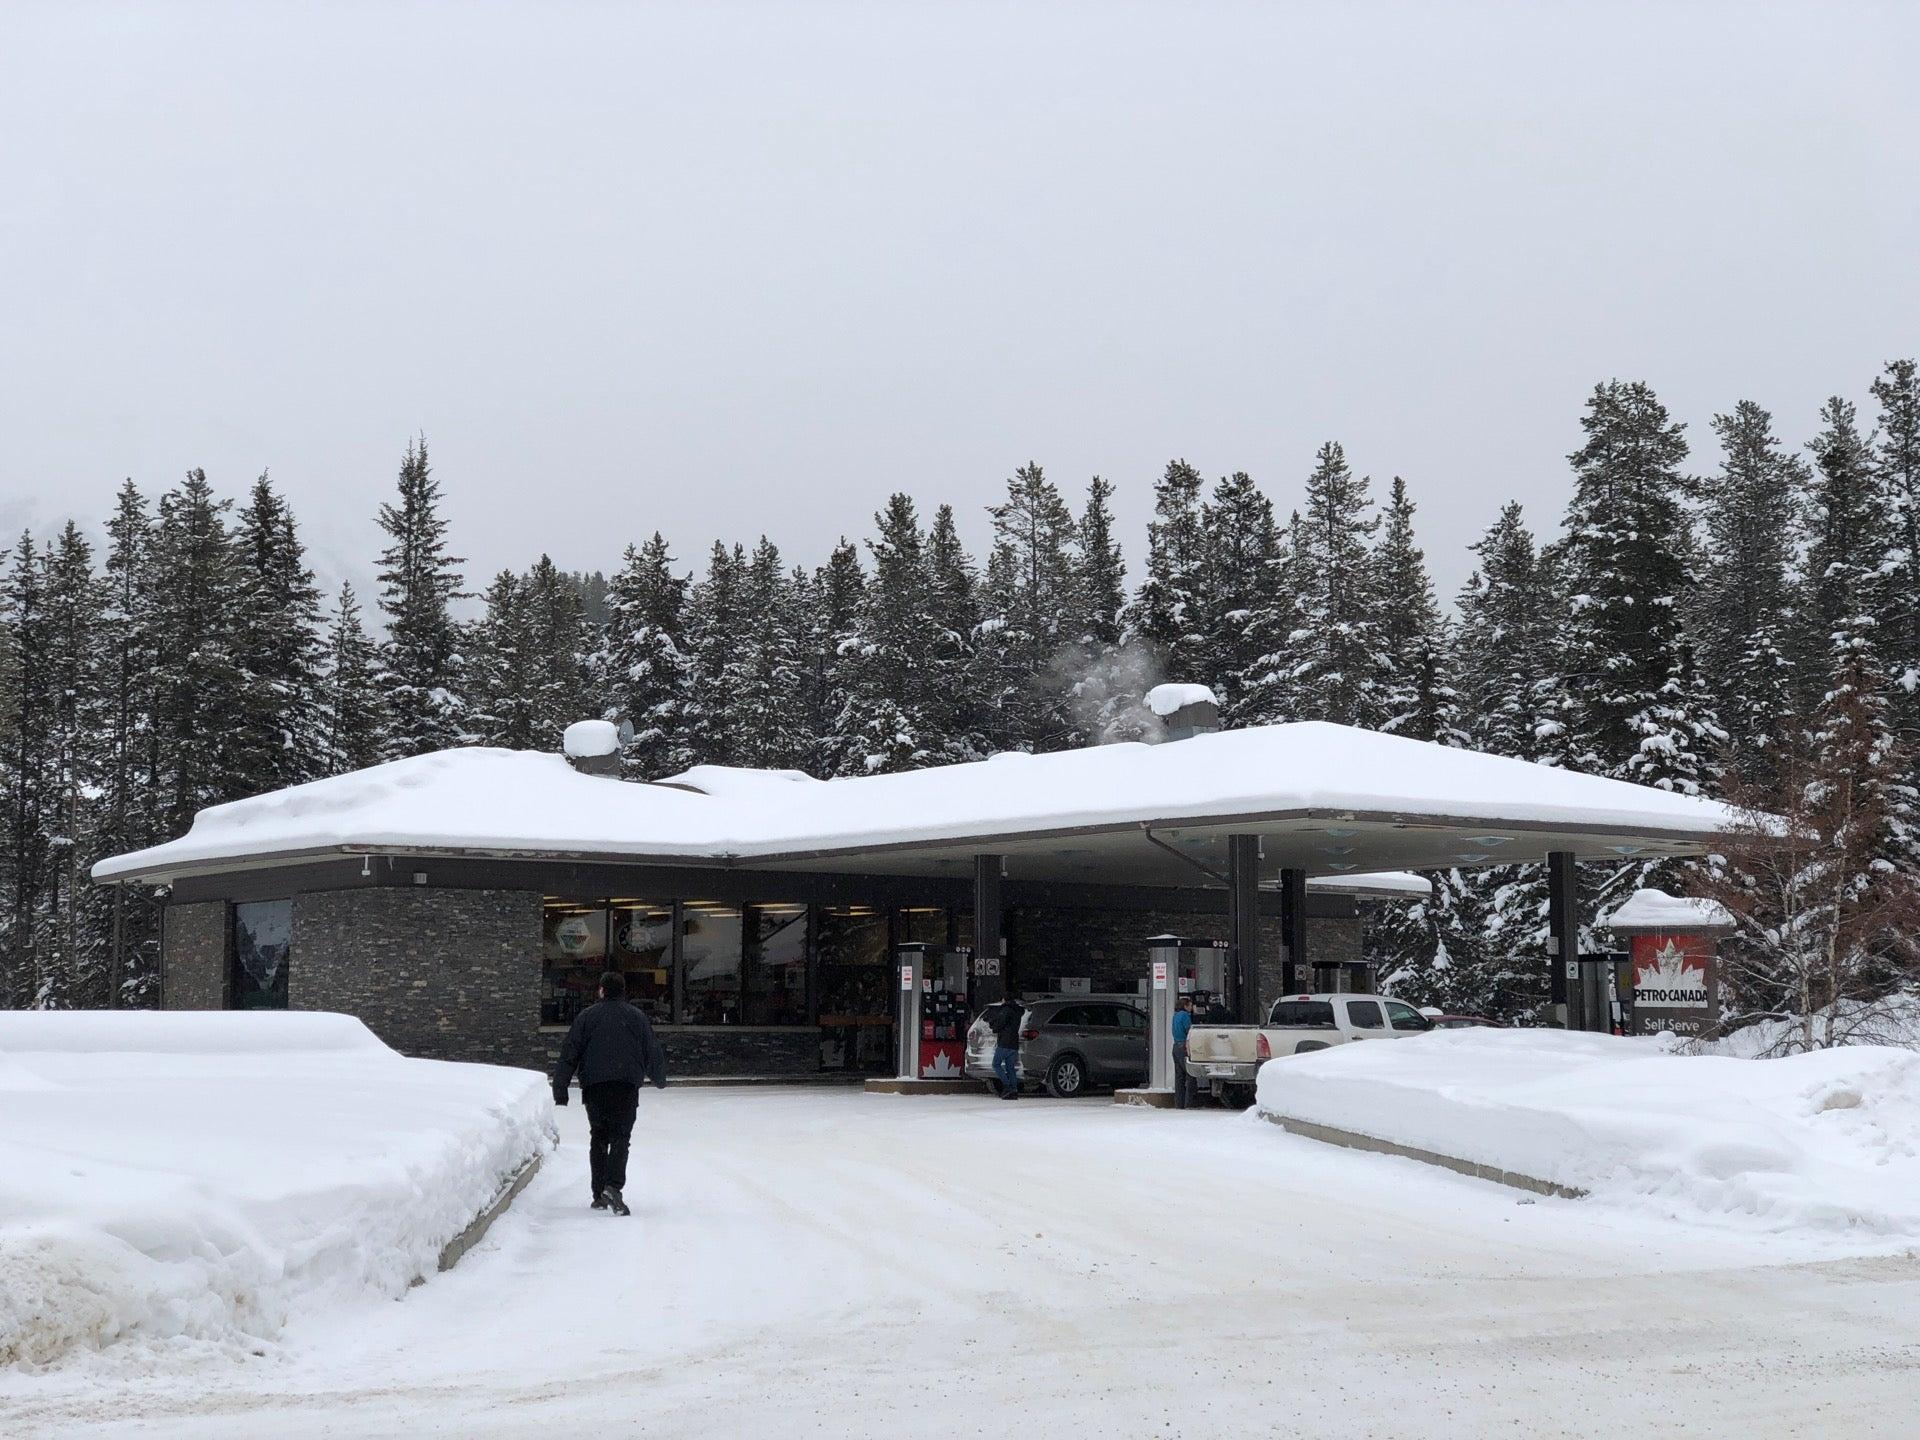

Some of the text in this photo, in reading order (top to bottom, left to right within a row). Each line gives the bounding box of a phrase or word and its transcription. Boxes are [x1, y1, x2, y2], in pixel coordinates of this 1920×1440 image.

[1634, 989, 1708, 1002] PETRO-CANADA
[1645, 1018, 1700, 1031] Self Serve
